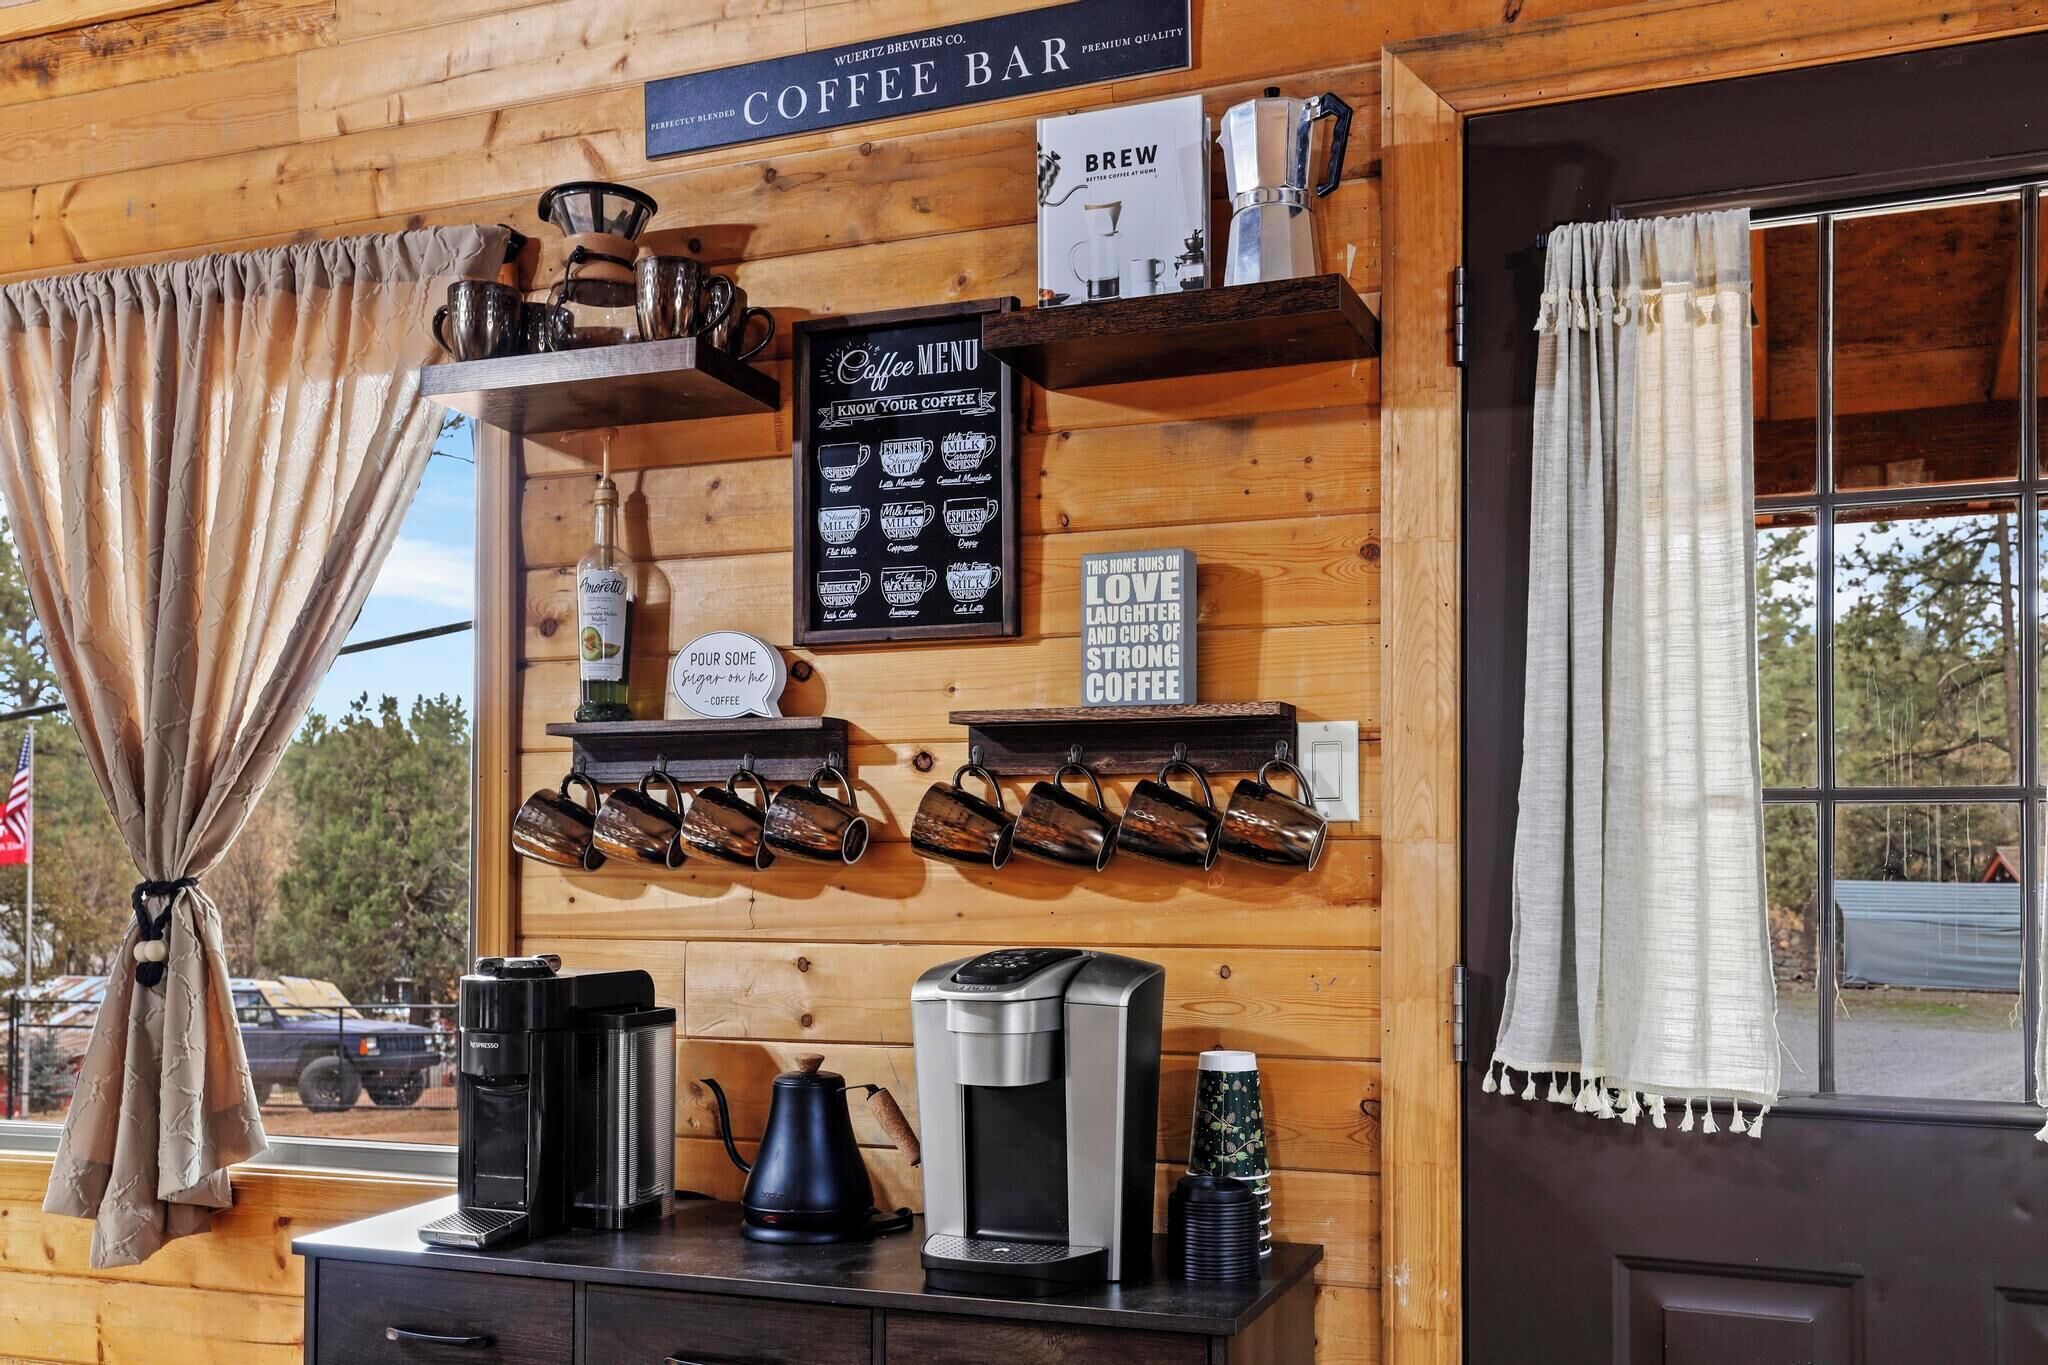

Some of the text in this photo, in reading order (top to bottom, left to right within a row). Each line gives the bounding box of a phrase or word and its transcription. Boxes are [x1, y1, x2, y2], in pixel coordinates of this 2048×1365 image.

[1081, 27, 1184, 54] PREMIUM QUALITY
[834, 33, 967, 67] WUERTZ BREWERS CO.
[743, 37, 1071, 126] COFFEE BAR
[651, 109, 736, 130] PERFECTLY BLENDED
[1085, 144, 1158, 173] BREW
[1086, 175, 1107, 183] BETTER
[1108, 171, 1130, 180] COFFEE
[1139, 168, 1157, 176] HOME
[837, 338, 979, 392] Coffee MENU
[837, 393, 976, 417] KNOW YOUR COFFEE
[946, 432, 964, 442] Milk
[883, 441, 922, 454] ESPRESSO
[947, 440, 980, 451] MILK
[945, 449, 982, 462] Caramel
[885, 463, 917, 474] MILK
[948, 459, 980, 470] ESPRESSO
[822, 467, 855, 479] ESPRESSO
[825, 511, 858, 521] Steamed
[883, 504, 925, 517] Milk Foam
[946, 509, 985, 523] ESPRESSO
[823, 520, 855, 531] MILK
[886, 517, 918, 528] MILK
[949, 522, 983, 534] ESPRESSO
[823, 531, 855, 542] ESPRESSO
[886, 528, 919, 538] ESPRESSO
[951, 562, 970, 571] Milk
[1086, 554, 1180, 575] THIS HOME RUNS ON
[895, 572, 915, 584] Hot
[952, 579, 986, 590] MILK
[580, 577, 626, 595] Amoretti
[819, 582, 859, 594] WHISKEY
[883, 578, 924, 592] WATER
[1086, 571, 1181, 605] LOVE
[822, 595, 855, 606] ESPRESSO
[887, 592, 921, 604] ESPRESSO
[953, 589, 985, 600] ESPRESSO
[838, 609, 858, 619] Coffee
[1086, 602, 1181, 625] LAUGHTER
[1087, 622, 1181, 645] AND CUPS OF
[690, 651, 757, 666] POUR SOME
[1086, 643, 1180, 671] STRONG
[728, 674, 746, 683] on
[748, 670, 768, 685] me
[1086, 669, 1180, 703] COFFEE
[469, 1040, 499, 1049] NESPRESSO
